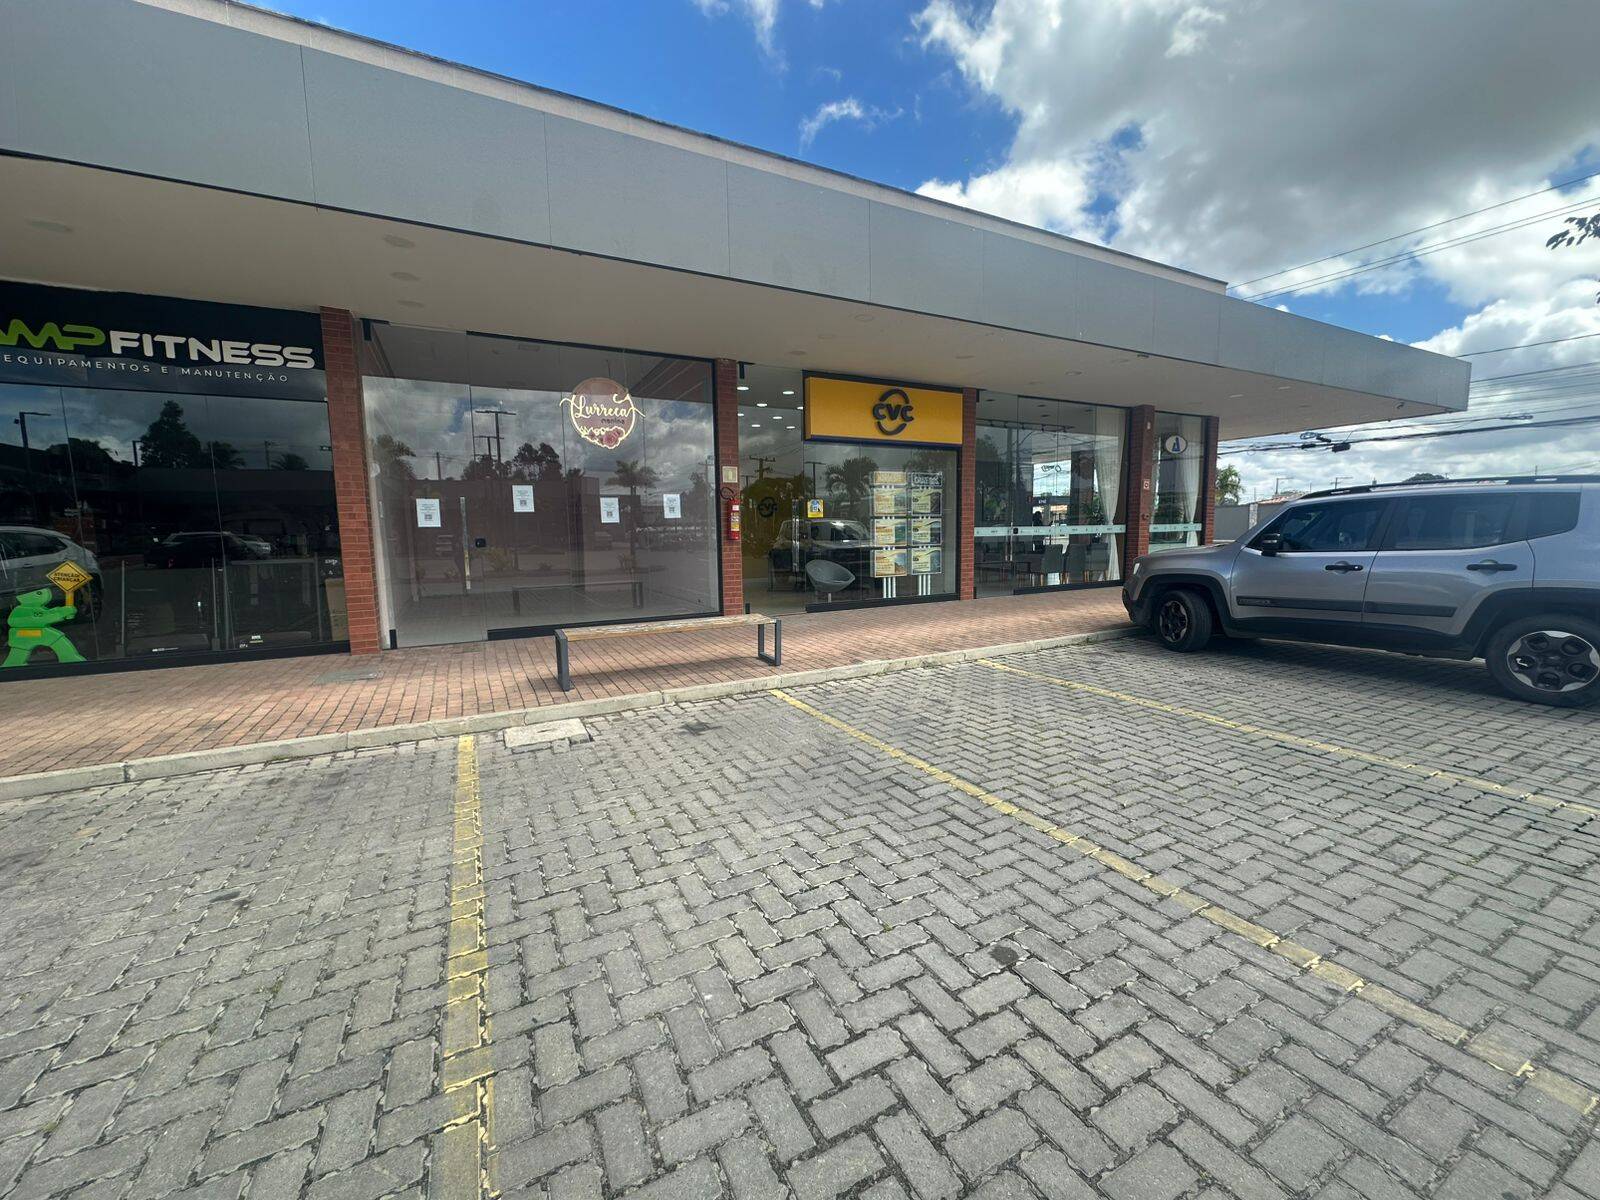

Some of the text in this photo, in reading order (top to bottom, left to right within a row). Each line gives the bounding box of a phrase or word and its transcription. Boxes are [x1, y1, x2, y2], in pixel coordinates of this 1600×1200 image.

[0, 318, 315, 369] MP FITNESS
[4, 354, 288, 382] EQUIPAMENTOS E MANUTENÇÃO
[873, 403, 914, 422] CVC
